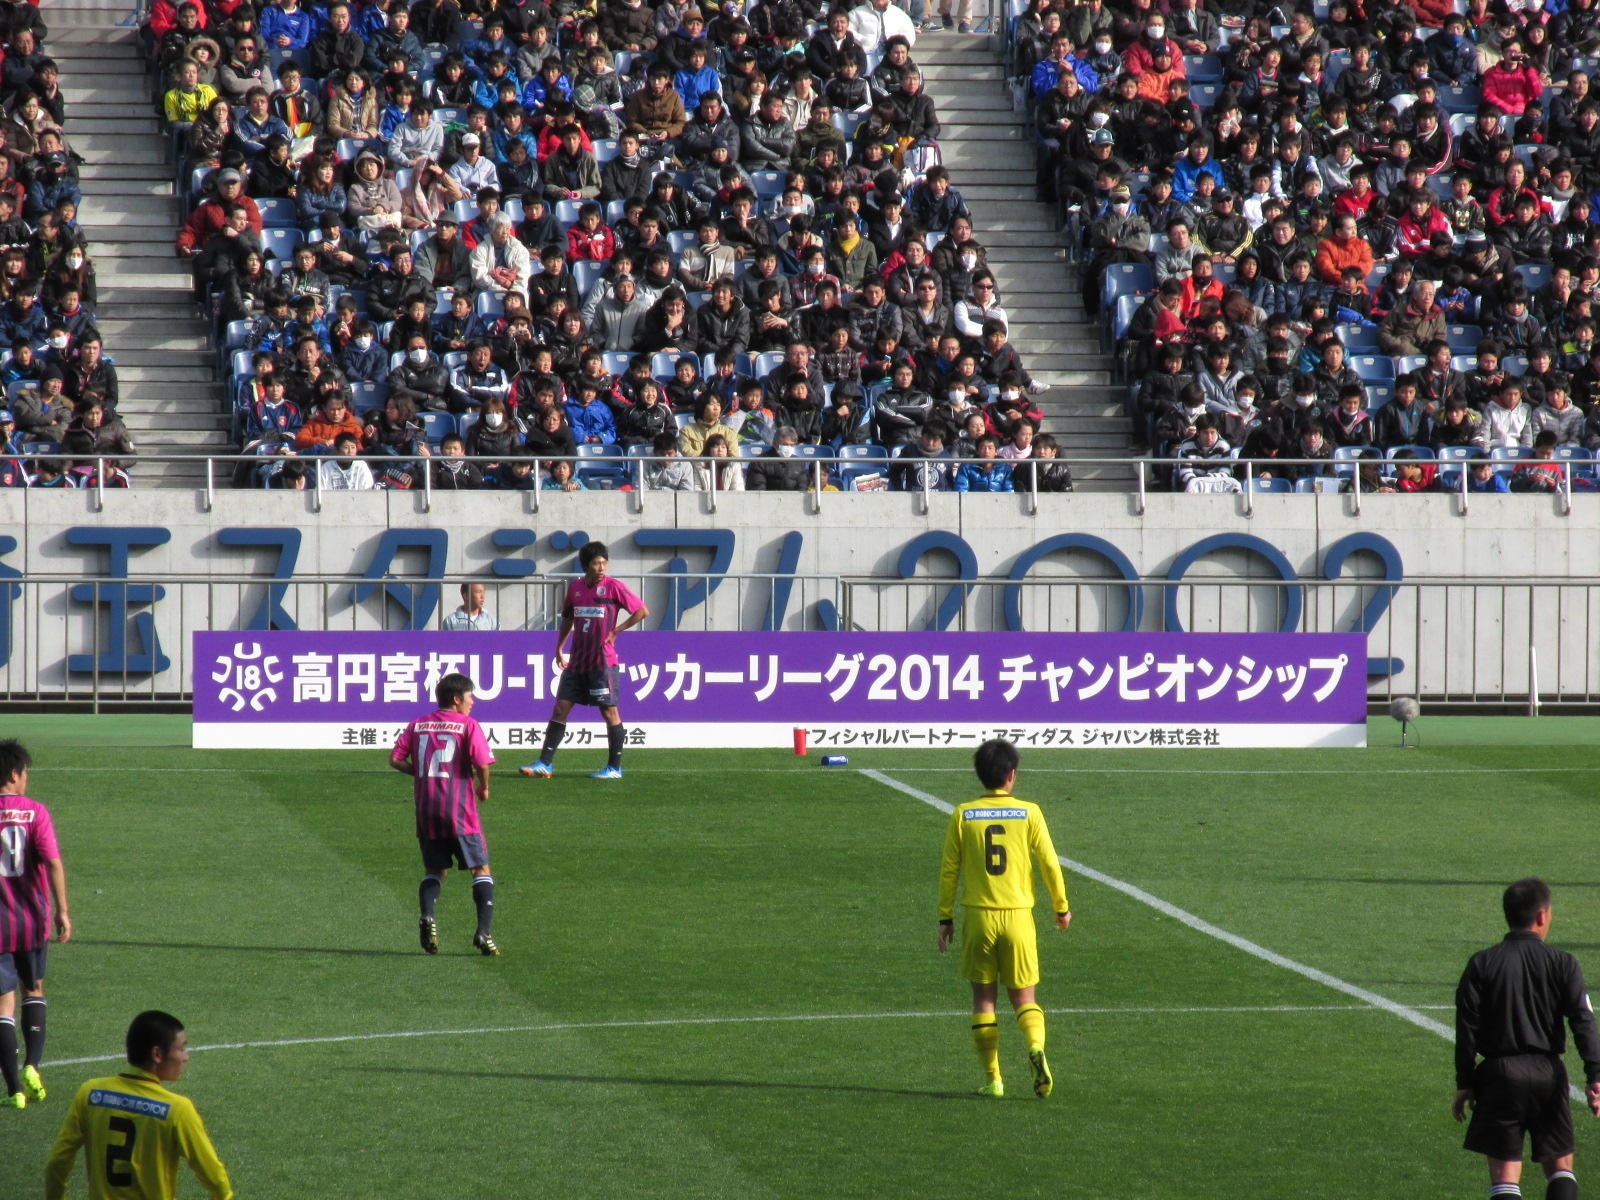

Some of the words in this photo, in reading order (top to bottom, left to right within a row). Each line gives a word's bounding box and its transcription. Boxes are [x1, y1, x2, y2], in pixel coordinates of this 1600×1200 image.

[236, 664, 260, 690] 18
[292, 651, 984, 703] 高円宮杯U-1ッカーリーグ2014
[1000, 652, 1349, 703] チャンピオンシップ
[418, 722, 462, 732] YANMAR
[508, 727, 647, 746] 日本ッカー会
[805, 727, 1074, 746] フィシャルパートナー：アディダス
[1082, 727, 1220, 746] ジャパン株式会社
[417, 734, 458, 778] 12
[0, 811, 32, 821] MAR
[984, 824, 1008, 876] 6
[106, 1115, 136, 1188] 2
